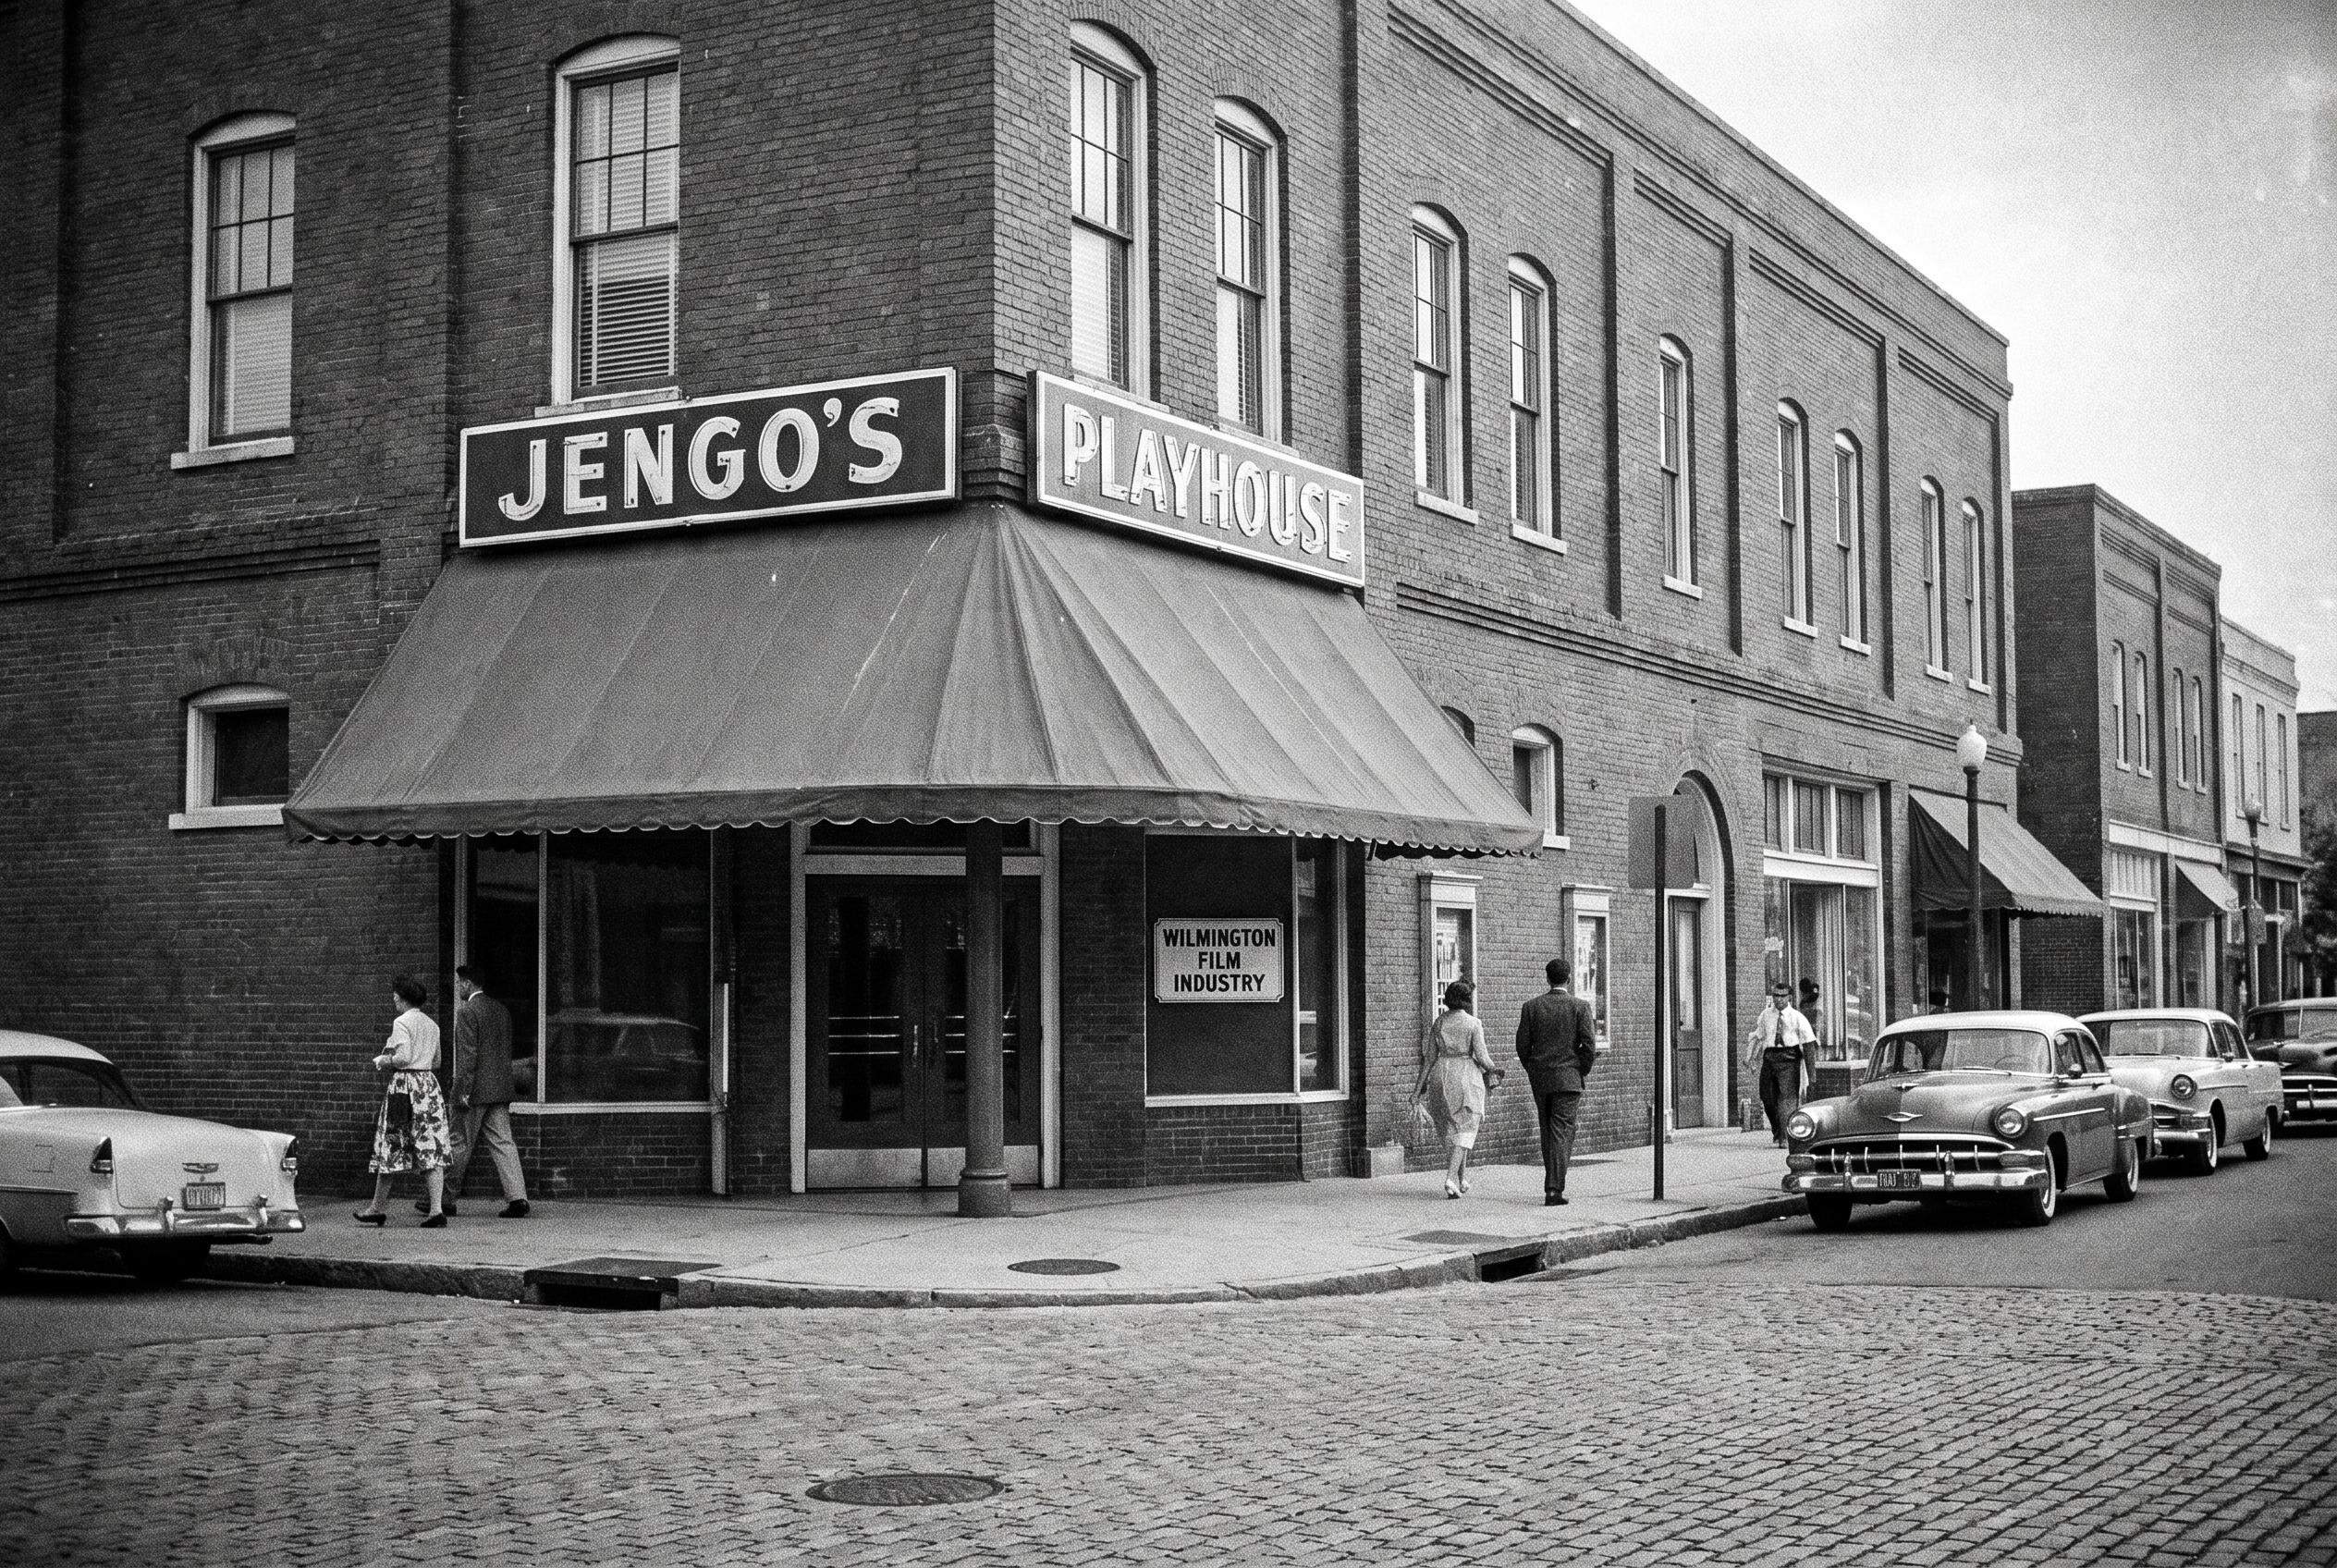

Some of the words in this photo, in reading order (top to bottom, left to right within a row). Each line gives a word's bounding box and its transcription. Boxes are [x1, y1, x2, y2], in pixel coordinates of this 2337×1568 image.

[497, 397, 903, 521] JENGO'S
[1062, 403, 1352, 563] PLAYHOUSE
[1162, 928, 1276, 948] WILMINGTON
[1198, 951, 1241, 970] FILM
[1174, 974, 1266, 992] INDUSTRY
